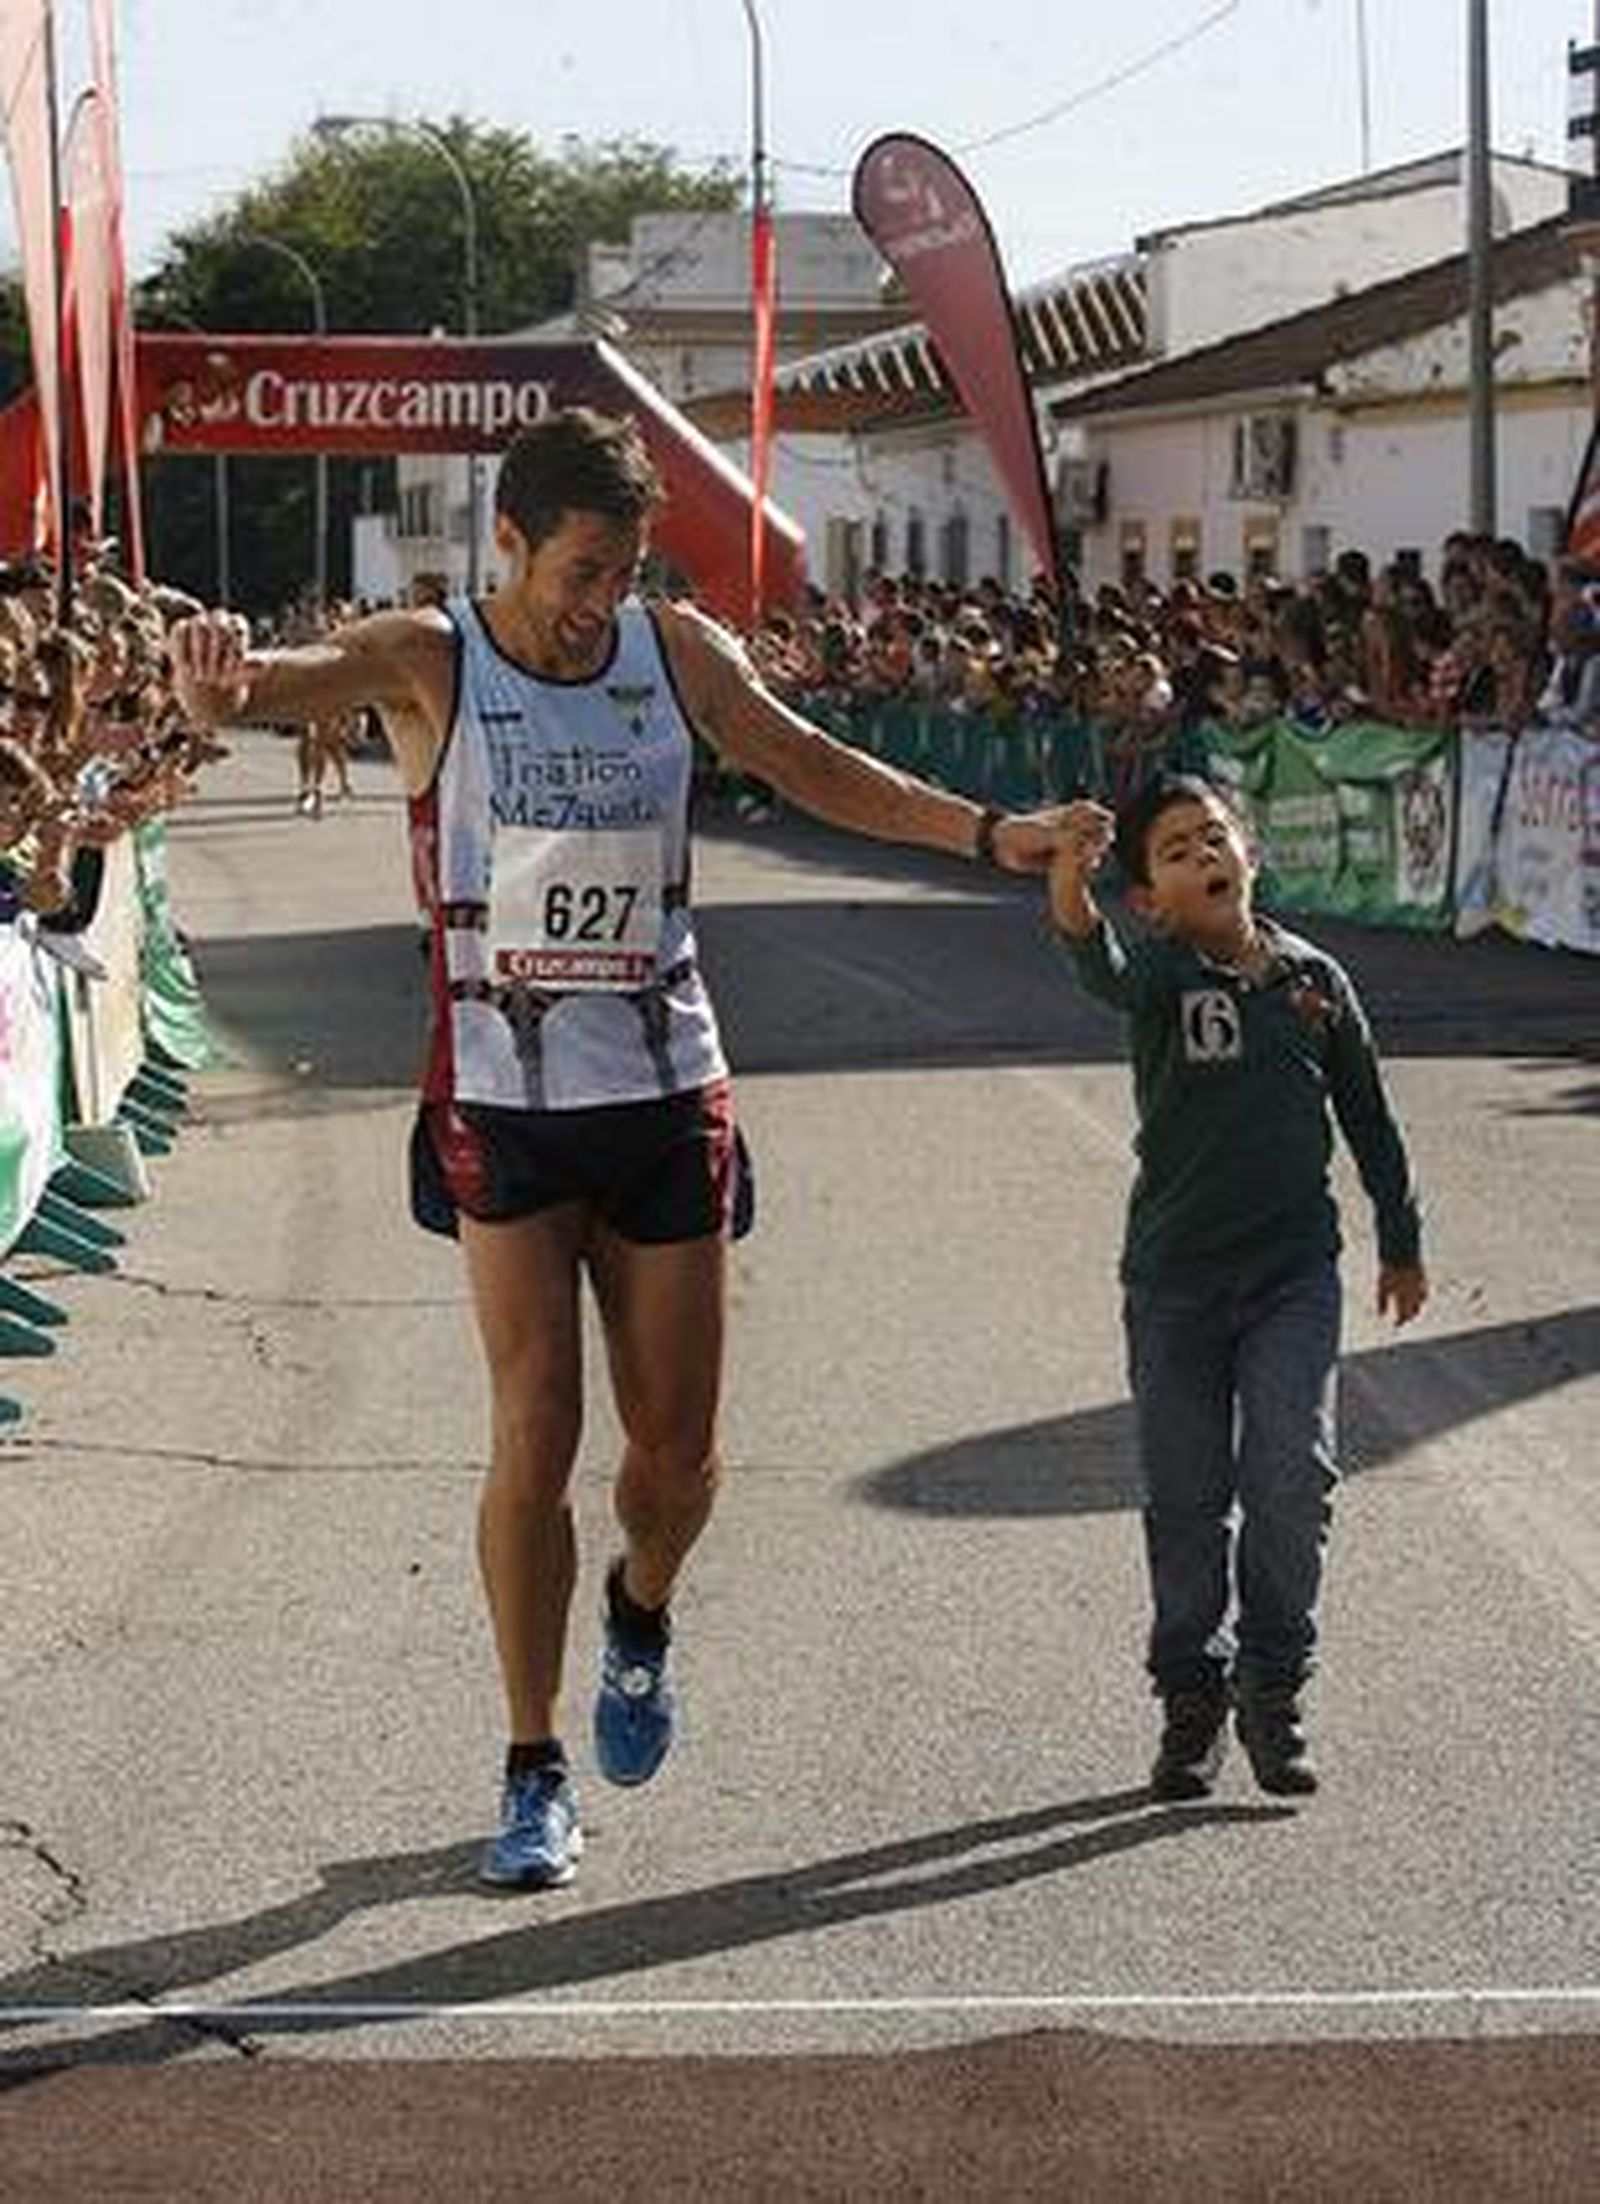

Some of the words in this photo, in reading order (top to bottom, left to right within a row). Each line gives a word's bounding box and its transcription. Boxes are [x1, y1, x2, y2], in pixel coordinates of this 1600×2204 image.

[245, 370, 549, 433] Cruzcampo
[545, 885, 639, 940] 627
[1191, 995, 1235, 1053] 6
